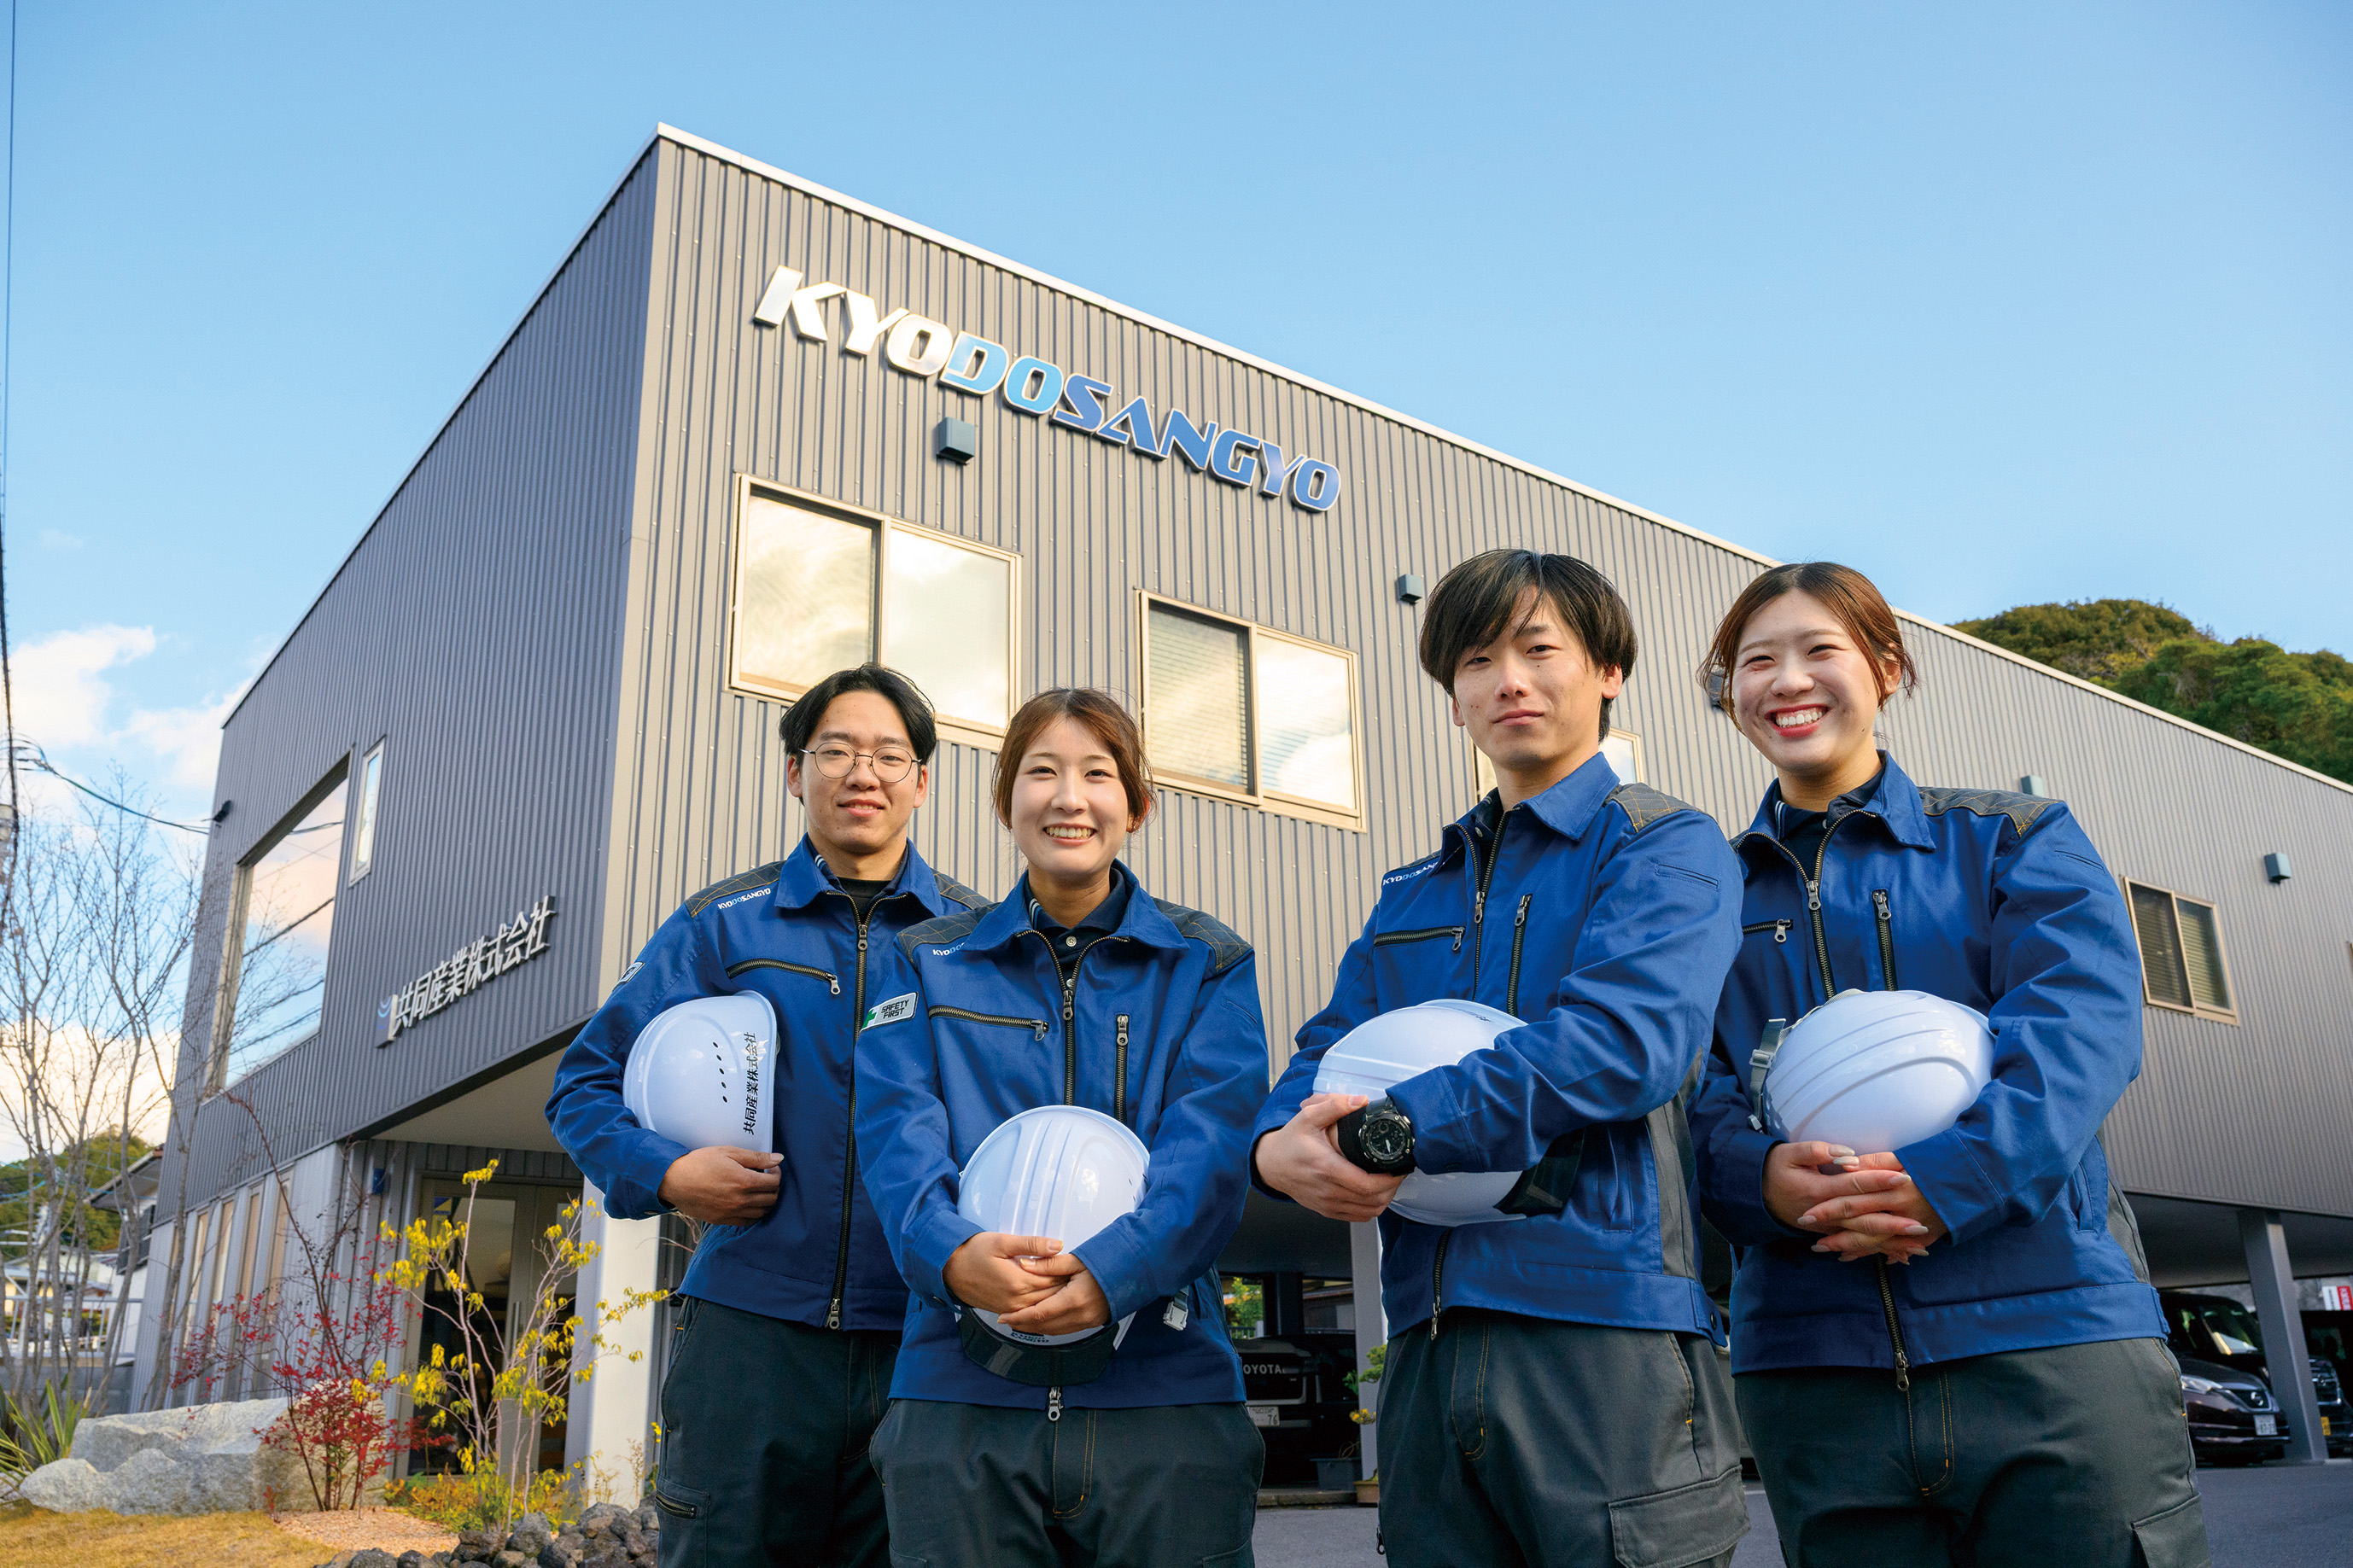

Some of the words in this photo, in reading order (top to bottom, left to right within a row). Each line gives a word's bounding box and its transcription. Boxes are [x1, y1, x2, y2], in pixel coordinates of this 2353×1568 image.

[754, 265, 1341, 512] KYODOSANGYO
[1382, 861, 1439, 886] KYODOSAN
[717, 888, 771, 910] KYODOSANGYO
[393, 895, 556, 1036] 共同産業株式会社
[881, 1000, 909, 1013] SAFETY
[883, 1007, 904, 1019] FIRST
[743, 1032, 758, 1135] 共同産業株式会社
[1243, 1364, 1282, 1374] OYOTA
